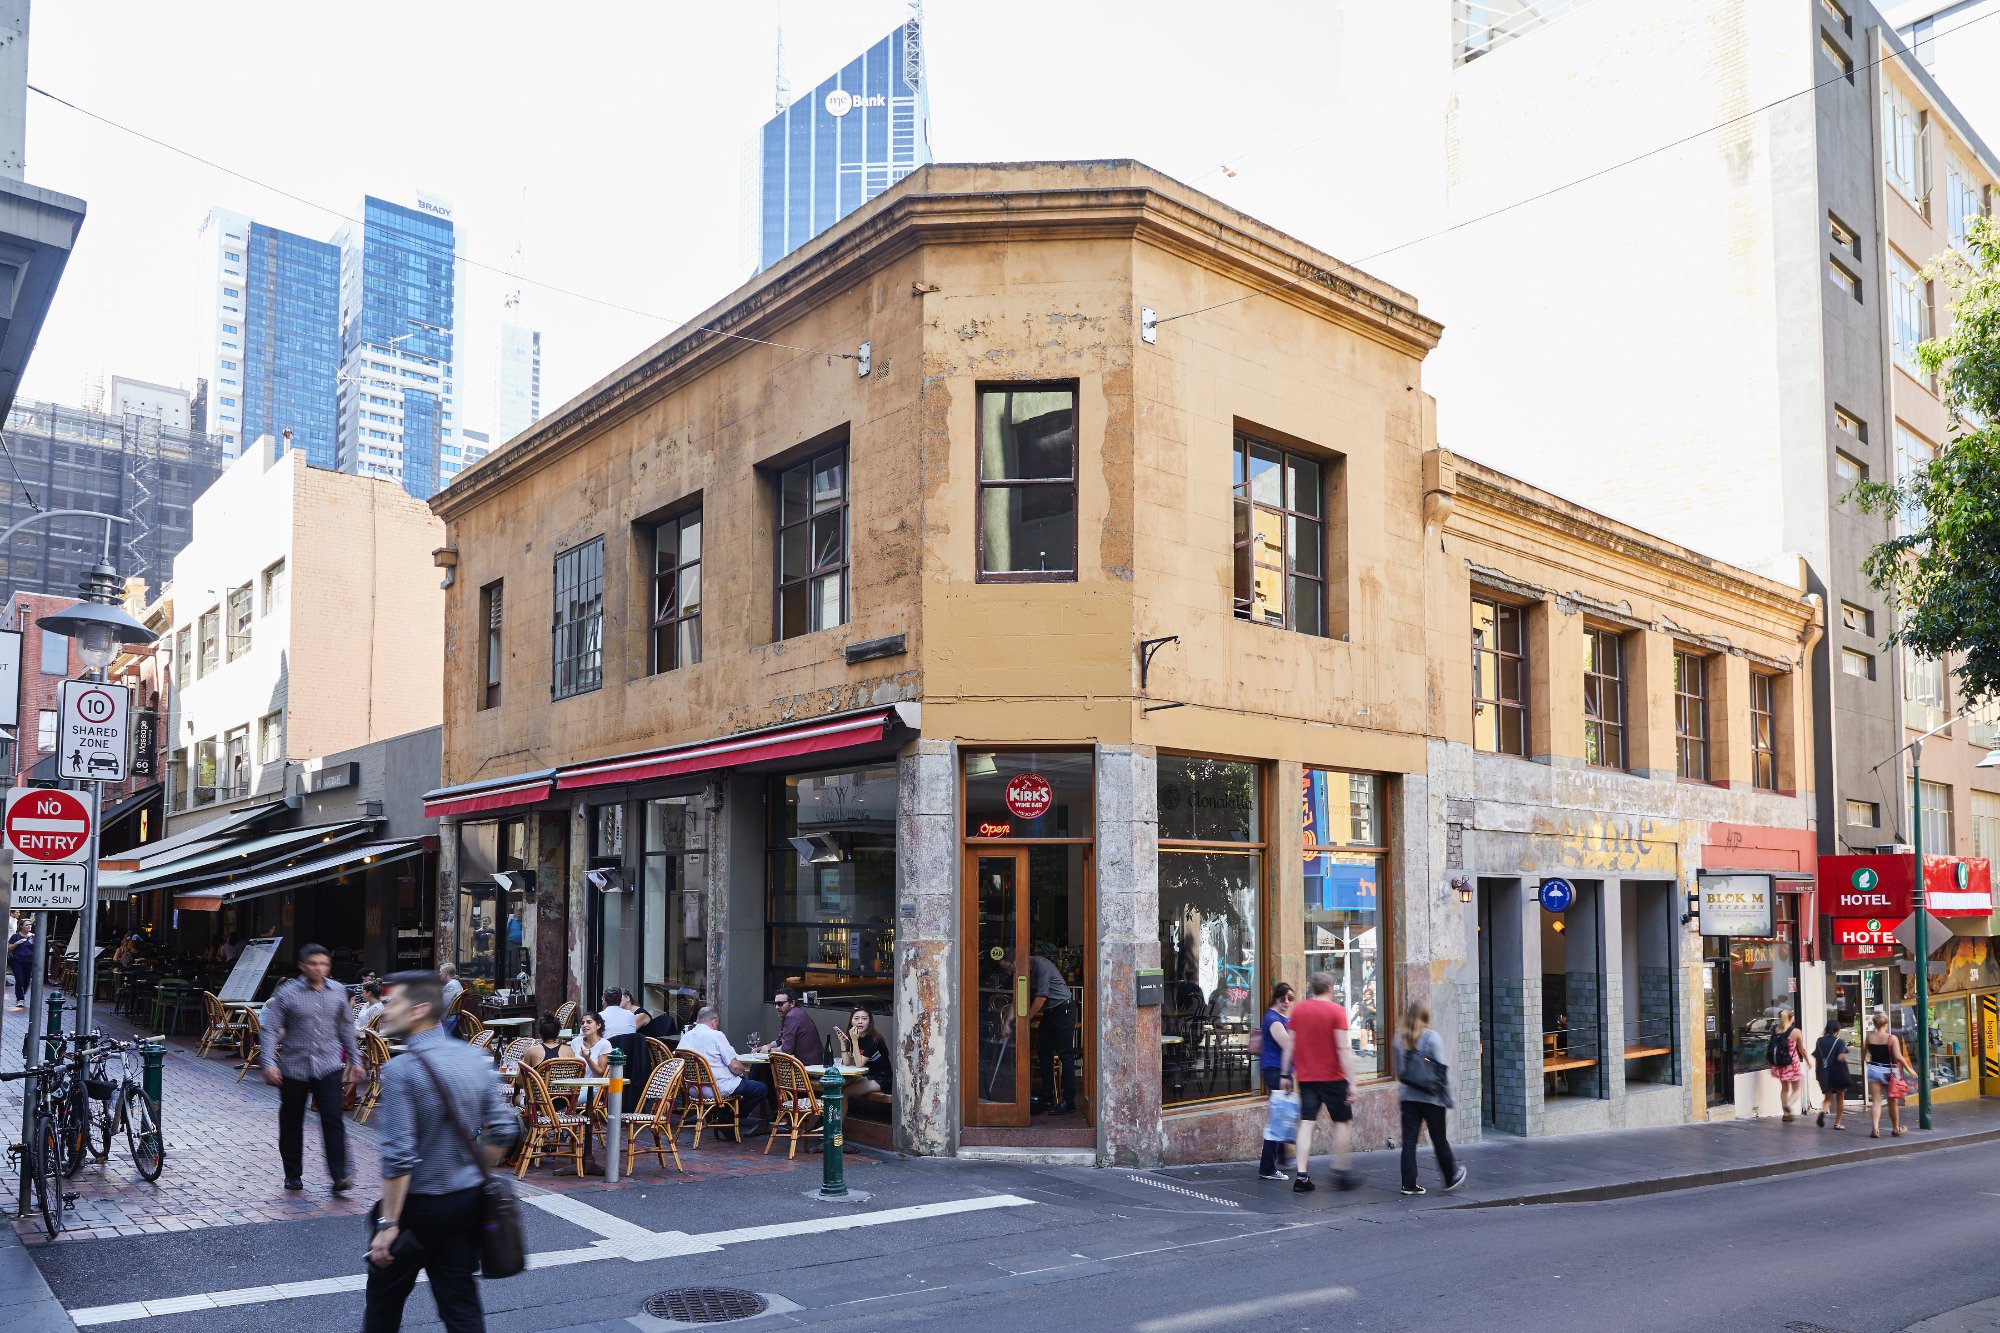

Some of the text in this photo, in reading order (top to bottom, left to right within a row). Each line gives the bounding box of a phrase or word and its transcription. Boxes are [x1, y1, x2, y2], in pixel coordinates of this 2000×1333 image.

[852, 93, 886, 108] Bank
[417, 199, 452, 217] BRADY
[87, 699, 105, 715] 10
[72, 725, 118, 738] SHARED
[79, 737, 110, 749] ZONE
[37, 800, 62, 816] NO
[980, 823, 1010, 837] Open
[19, 834, 79, 850] ENTRY
[18, 895, 42, 904] MON
[51, 896, 72, 904] SUN
[1706, 893, 1764, 903] BLOK M
[1840, 894, 1892, 906] HOTEL
